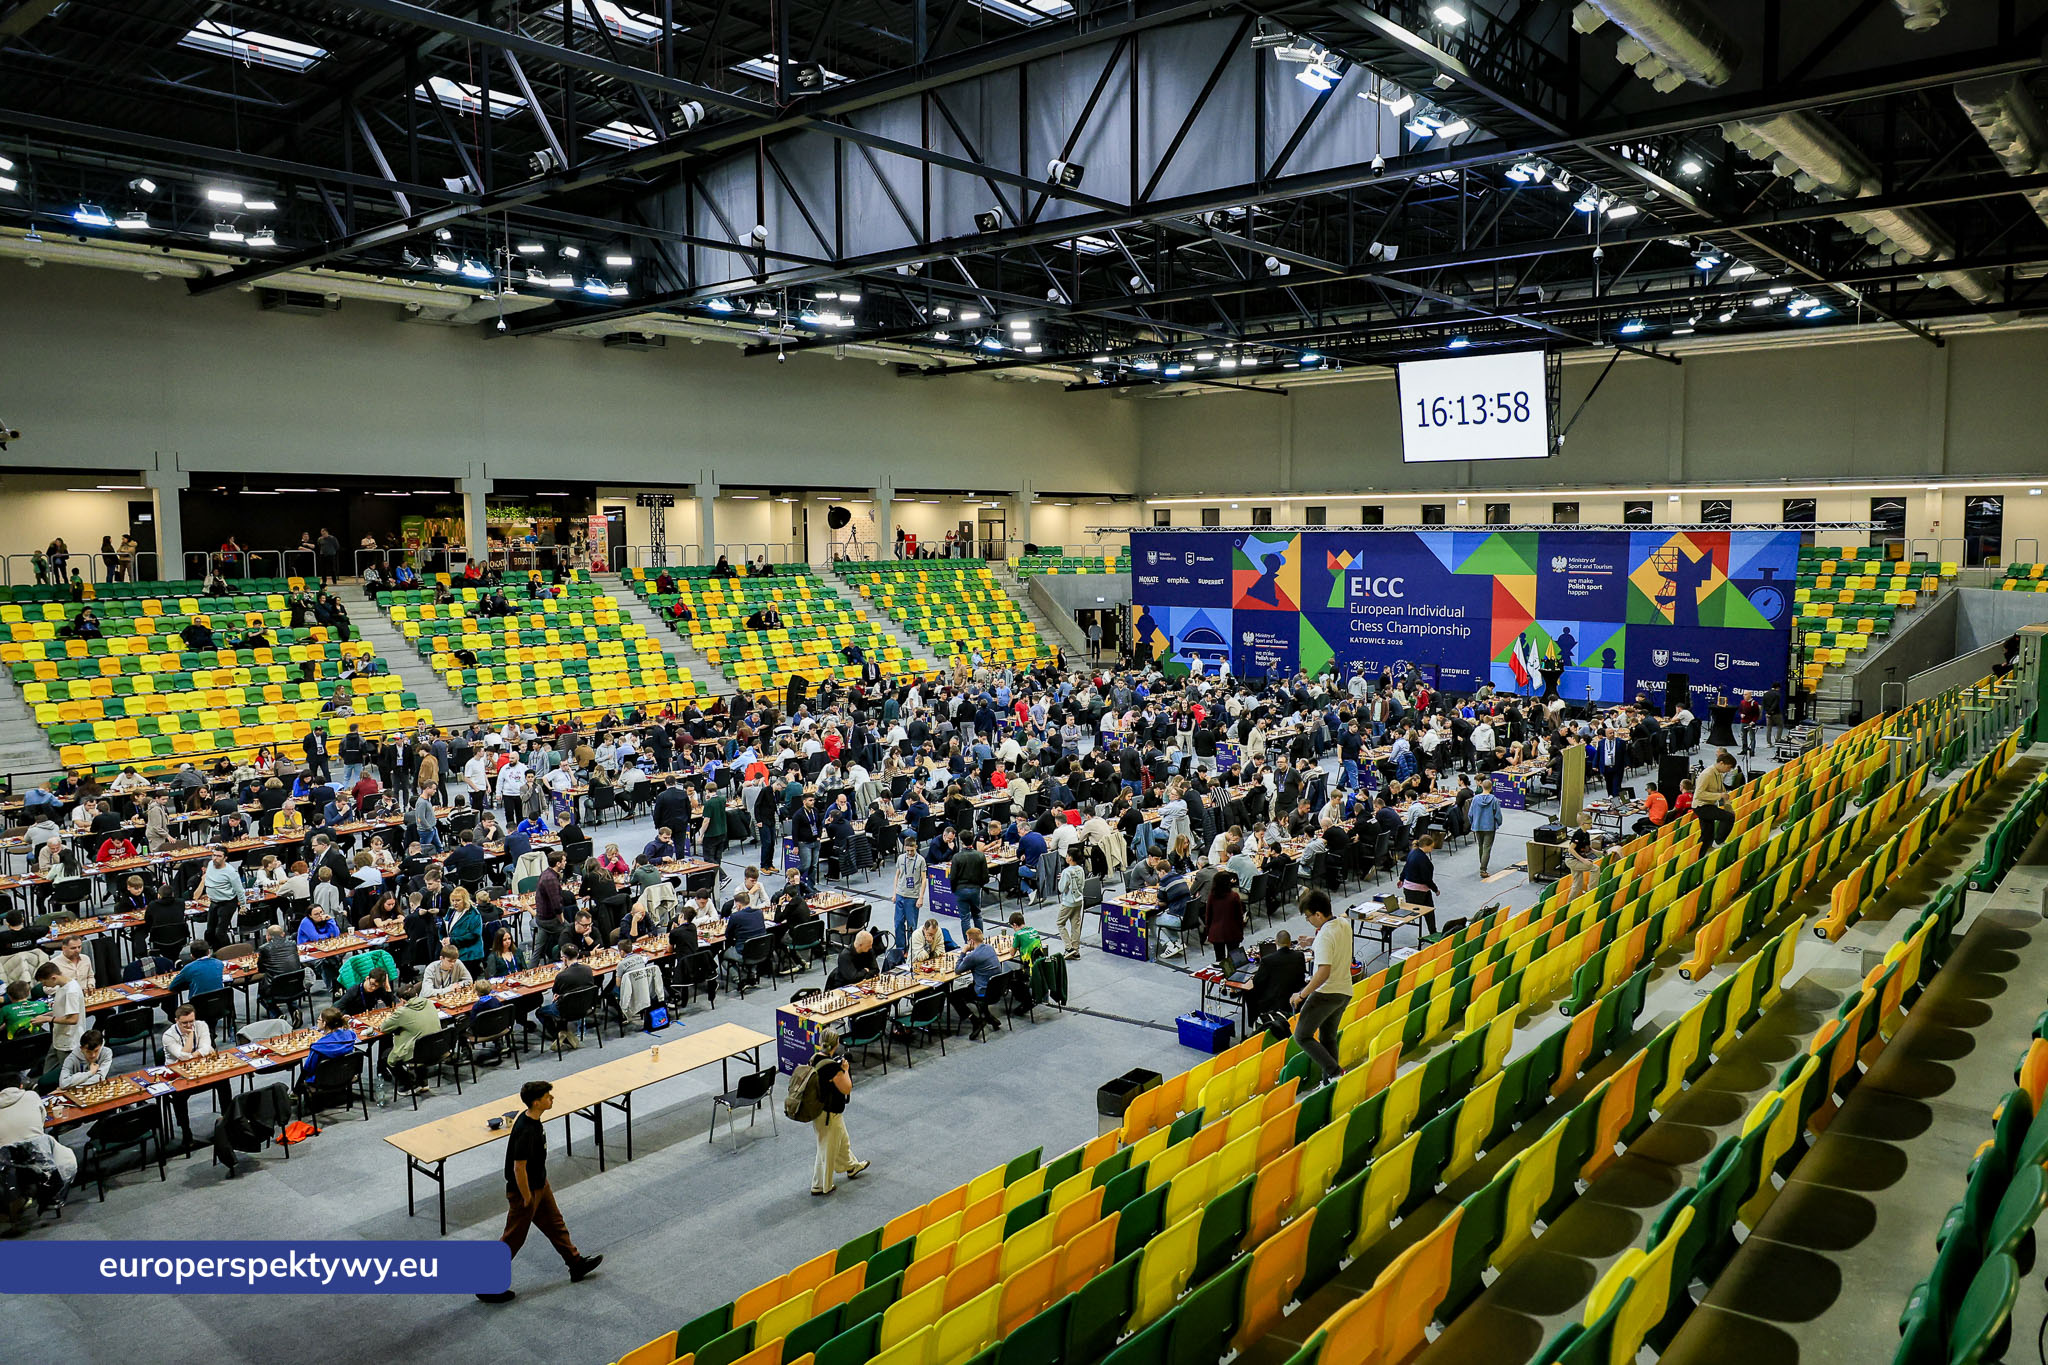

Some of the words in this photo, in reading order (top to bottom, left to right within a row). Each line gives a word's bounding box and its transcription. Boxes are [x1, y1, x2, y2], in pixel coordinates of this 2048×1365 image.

[1417, 391, 1530, 427] 16:13:58
[1350, 602, 1404, 617] European
[1407, 604, 1465, 618] Individual
[1350, 619, 1383, 632] Chess
[1386, 621, 1471, 639] Championship
[1350, 637, 1386, 645] KATOWICE
[1689, 684, 1719, 694] mphie.
